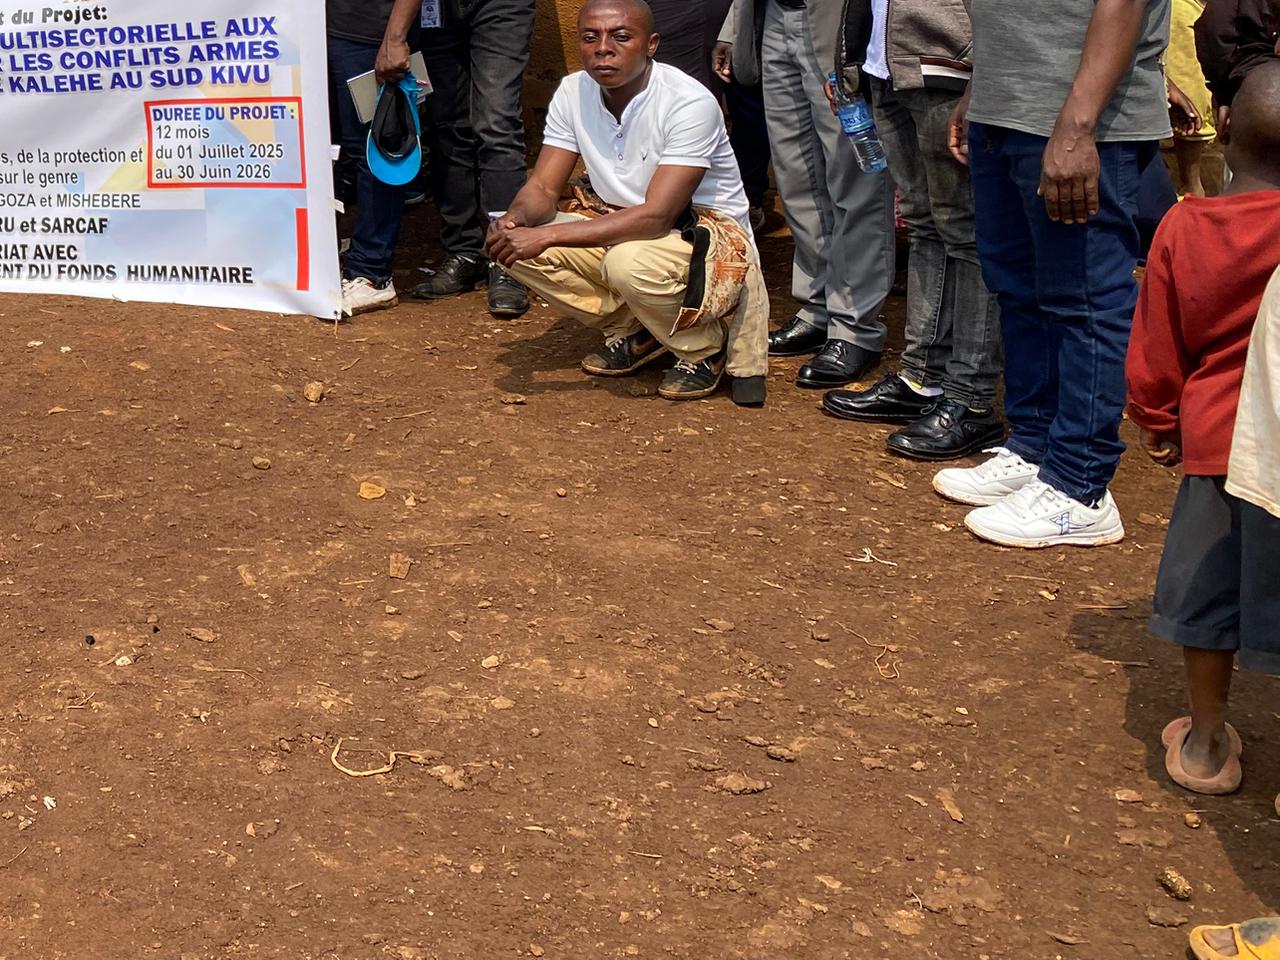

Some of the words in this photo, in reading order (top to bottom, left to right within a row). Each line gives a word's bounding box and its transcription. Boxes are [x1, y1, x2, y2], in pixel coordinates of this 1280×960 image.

[11, 8, 34, 25] du
[42, 6, 108, 24] Projet:
[225, 16, 277, 38] AUX
[9, 52, 53, 73] LES
[60, 45, 181, 70] CONFLITS
[187, 39, 281, 64] ARMES
[8, 73, 103, 93] KALEHE
[109, 70, 143, 90] AU
[150, 67, 203, 88] SUD
[210, 63, 271, 85] KIVU
[152, 108, 201, 122] DUREE
[205, 107, 225, 121] DU
[230, 105, 287, 120] PROJET
[155, 125, 172, 139] 12
[175, 125, 210, 139] mois
[17, 149, 35, 164] de
[38, 149, 50, 164] la
[54, 147, 126, 167] protection
[130, 148, 144, 163] et
[155, 145, 172, 159] du
[177, 145, 193, 159] 01
[198, 144, 245, 159] Juillet
[249, 143, 284, 158] 2025
[23, 170, 35, 184] le
[38, 171, 79, 188] genre
[155, 167, 172, 179] au
[177, 165, 195, 179] 30
[199, 164, 232, 179] Juin
[236, 163, 271, 179] 2026
[40, 195, 53, 208] et
[56, 194, 141, 209] MISHEBERE
[20, 218, 36, 233] et
[40, 217, 109, 234] SARCAF
[33, 244, 78, 260] AVEC
[28, 264, 52, 280] DU
[57, 264, 117, 281] FONDS
[127, 265, 253, 284] HUMANITAIRE
